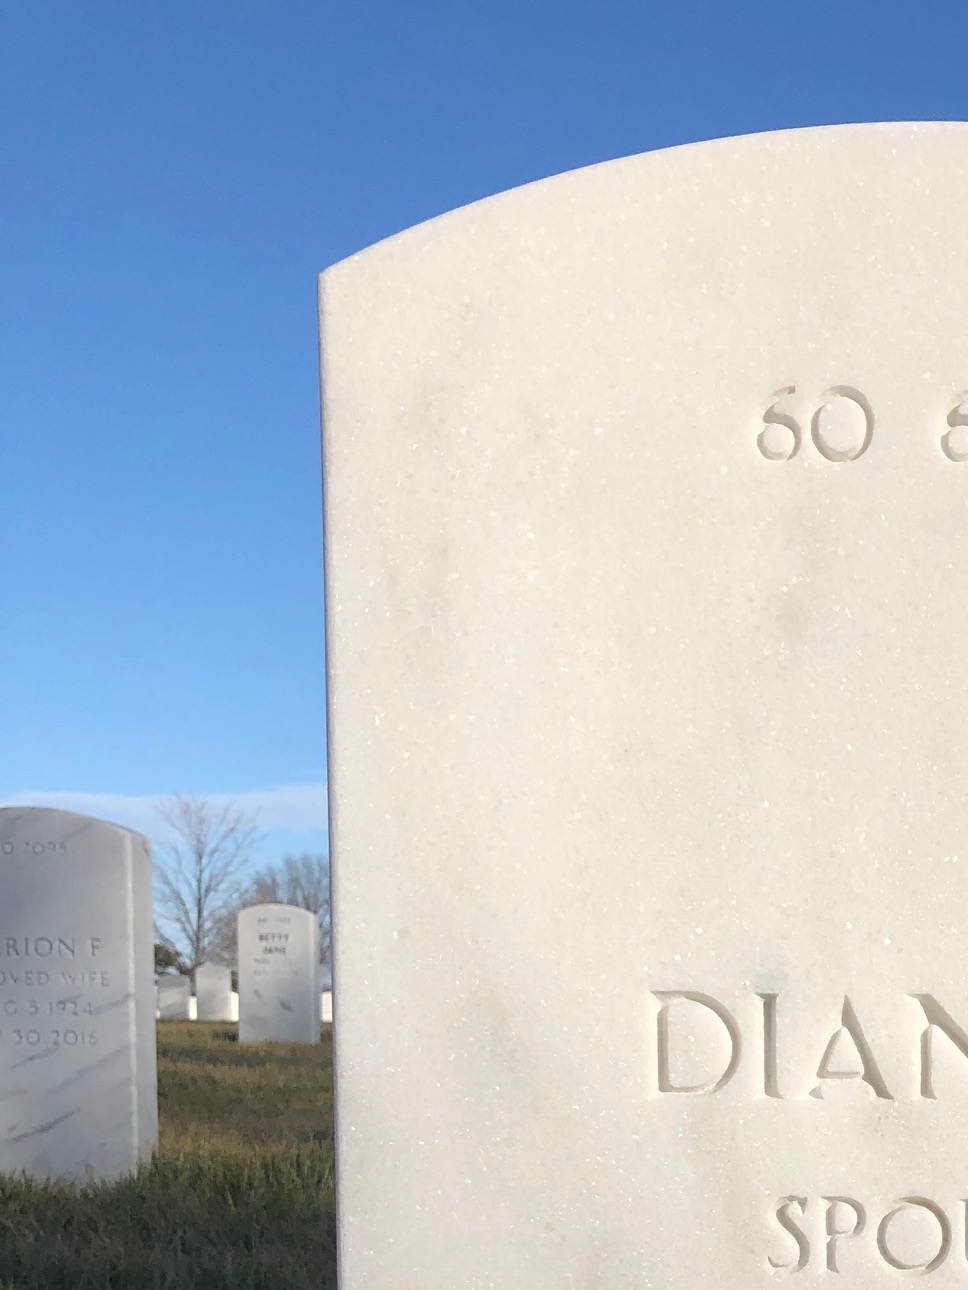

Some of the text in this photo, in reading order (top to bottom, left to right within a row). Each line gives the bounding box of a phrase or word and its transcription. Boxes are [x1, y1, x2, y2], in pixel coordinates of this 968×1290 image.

[757, 384, 874, 463] 60
[0, 936, 101, 957] RION F
[61, 970, 110, 987] WIFE
[28, 1000, 39, 1016] 5
[13, 1029, 41, 1046] 30
